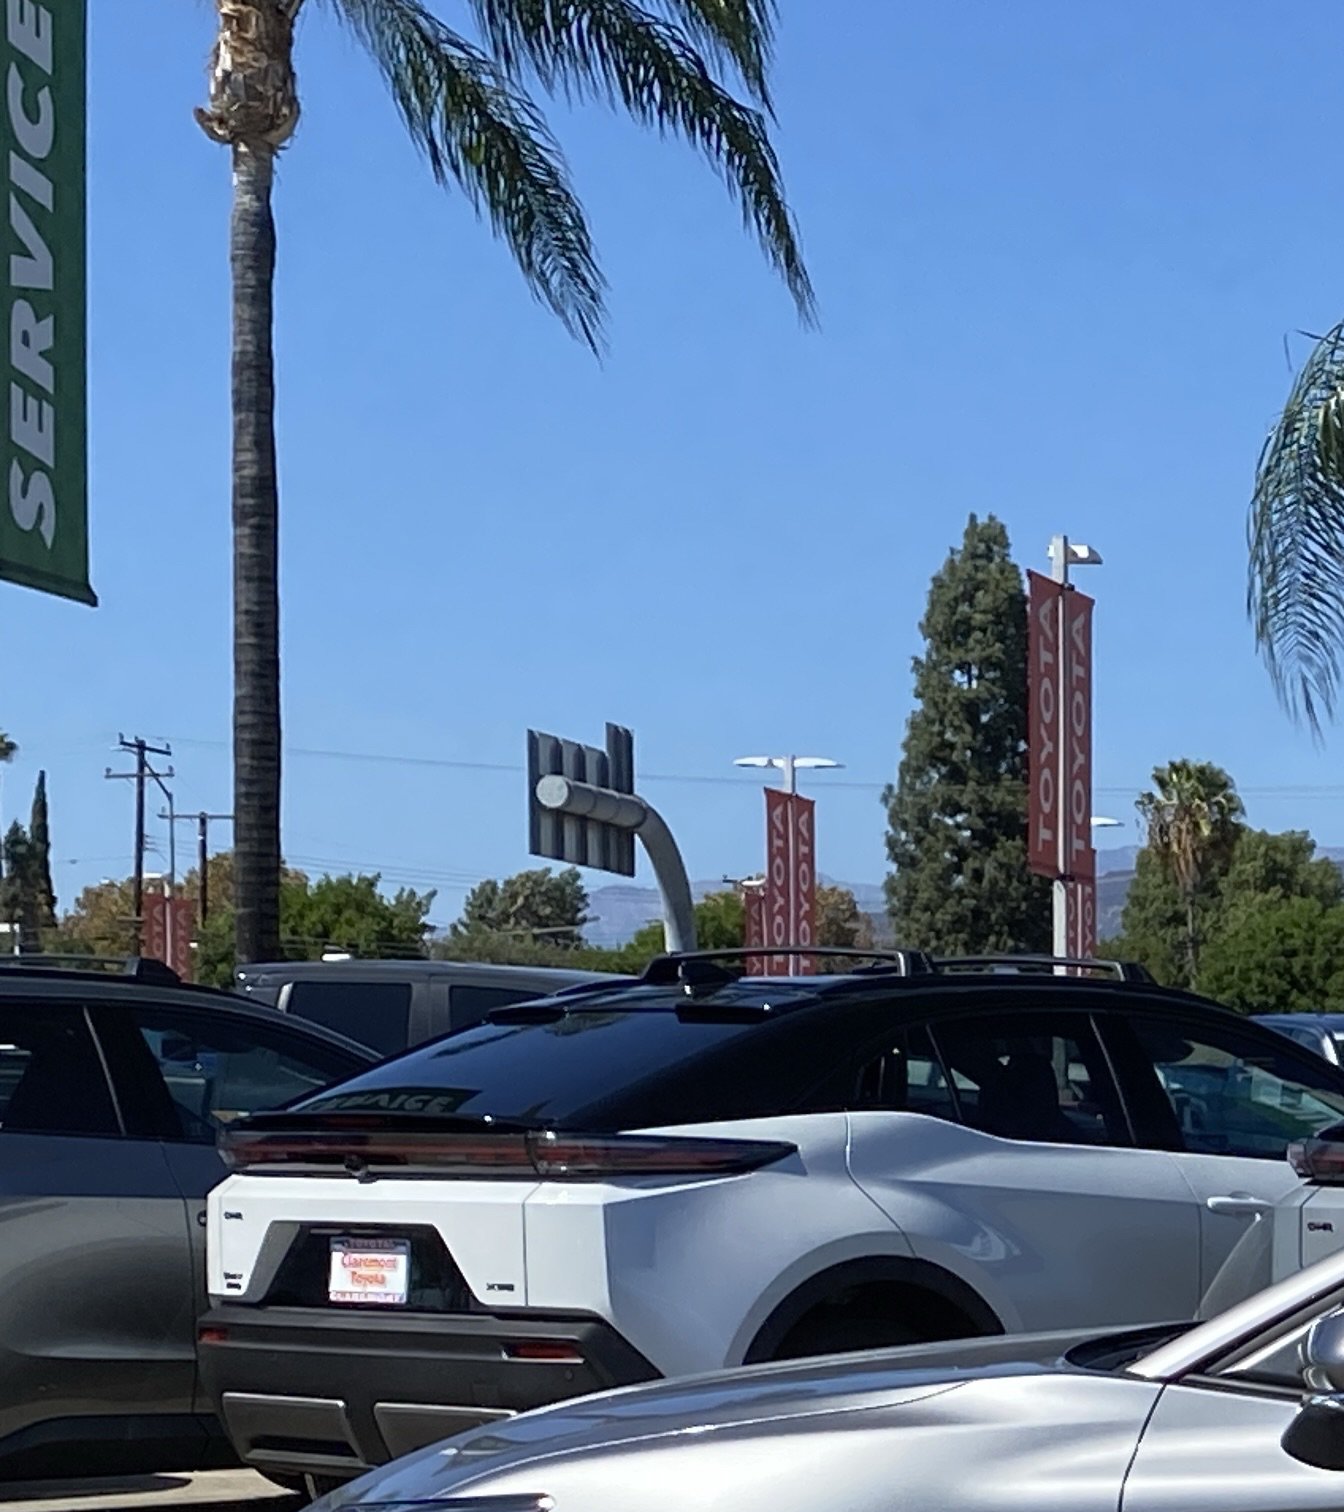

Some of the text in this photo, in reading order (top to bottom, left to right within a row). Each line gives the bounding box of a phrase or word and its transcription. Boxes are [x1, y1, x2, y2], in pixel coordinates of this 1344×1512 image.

[7, 0, 56, 550] SERVICE
[1038, 597, 1055, 852] TOYOTA
[1071, 610, 1087, 862] TOYOTA
